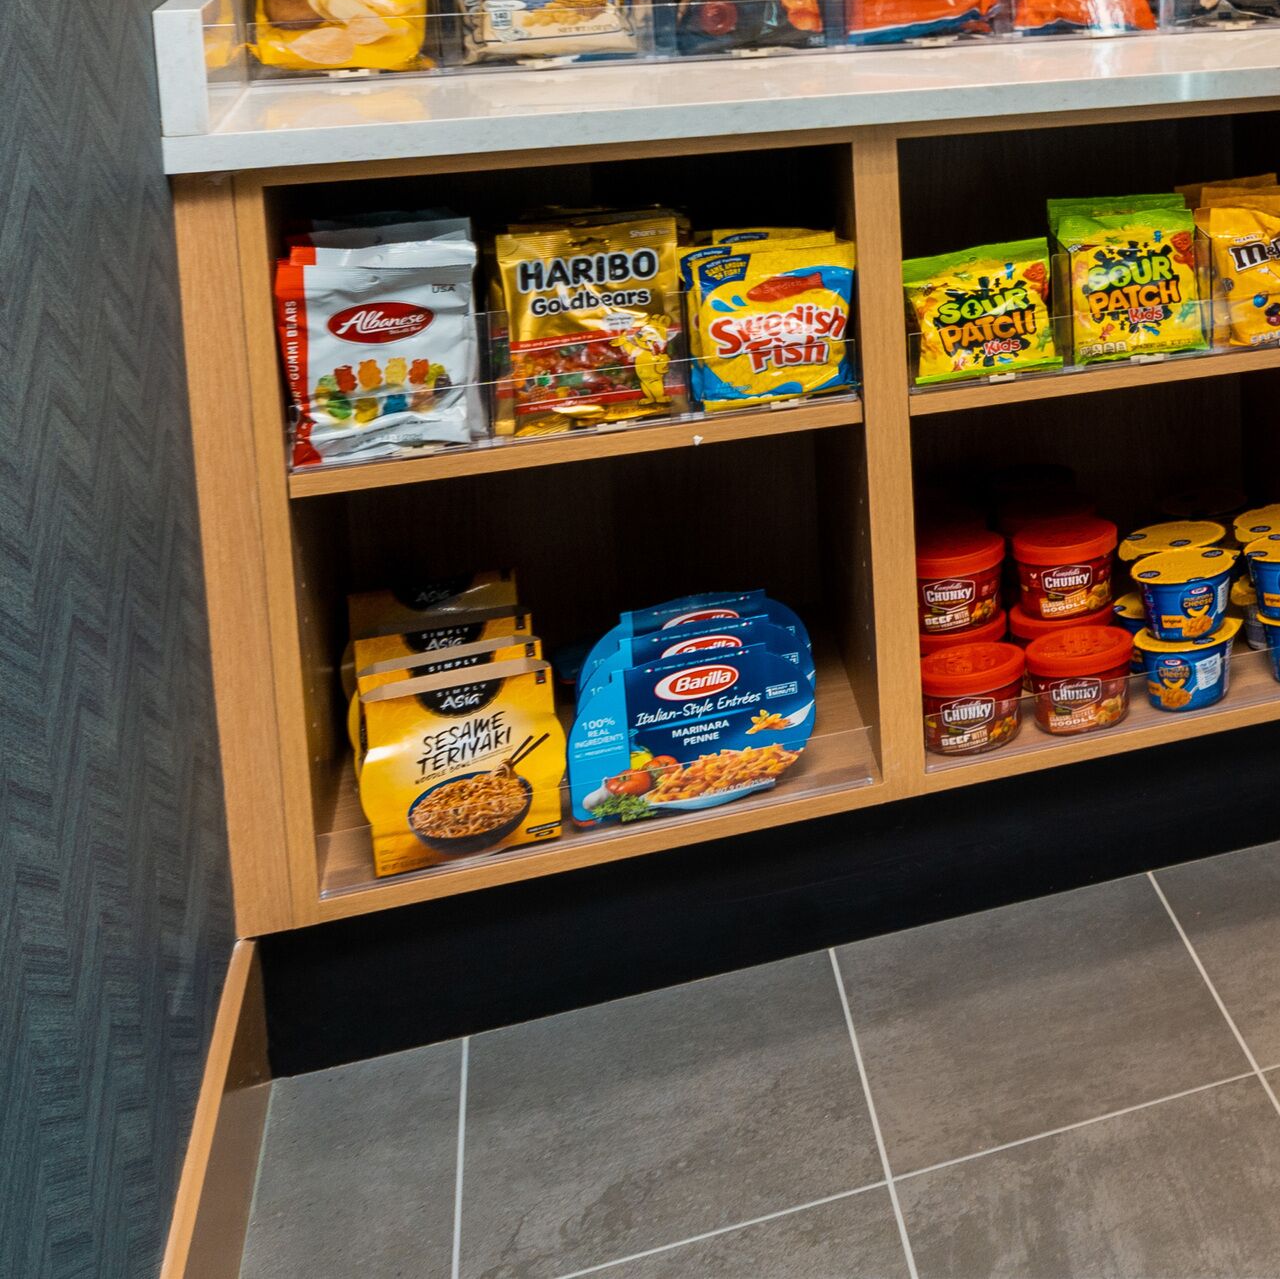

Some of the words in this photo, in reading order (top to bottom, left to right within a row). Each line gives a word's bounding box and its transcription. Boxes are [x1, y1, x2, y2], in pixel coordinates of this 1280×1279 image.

[518, 249, 658, 293] HARIBO
[1088, 255, 1173, 292] SOUR
[530, 288, 650, 317] Goldbears
[939, 287, 1030, 321] SOUR
[1089, 279, 1181, 314] PATCH
[337, 310, 427, 335] Albanese
[1128, 306, 1164, 324] Kids
[710, 305, 847, 356] Swedish
[940, 310, 1035, 349] PATCH
[745, 334, 828, 372] Fish
[984, 338, 1021, 356] Kids
[286, 340, 299, 381] GUMMI
[1044, 573, 1089, 589] CHUNKY
[926, 587, 972, 603] CHUNKY
[437, 683, 486, 698] SIMPLY
[674, 670, 732, 693] Barilla
[440, 691, 480, 711] Asia
[1052, 685, 1098, 702] CHUNKY
[634, 699, 713, 727] Italian-Style
[716, 692, 761, 712] Entrées
[943, 703, 992, 722] CHUNKY
[422, 710, 506, 756] SESAME
[582, 717, 615, 731] 100%
[587, 728, 610, 738] REAL
[671, 719, 730, 738] MARINARA
[574, 733, 624, 749] INGREDIENTS
[683, 731, 720, 746] PENNE
[416, 726, 512, 775] TERIYAKI
